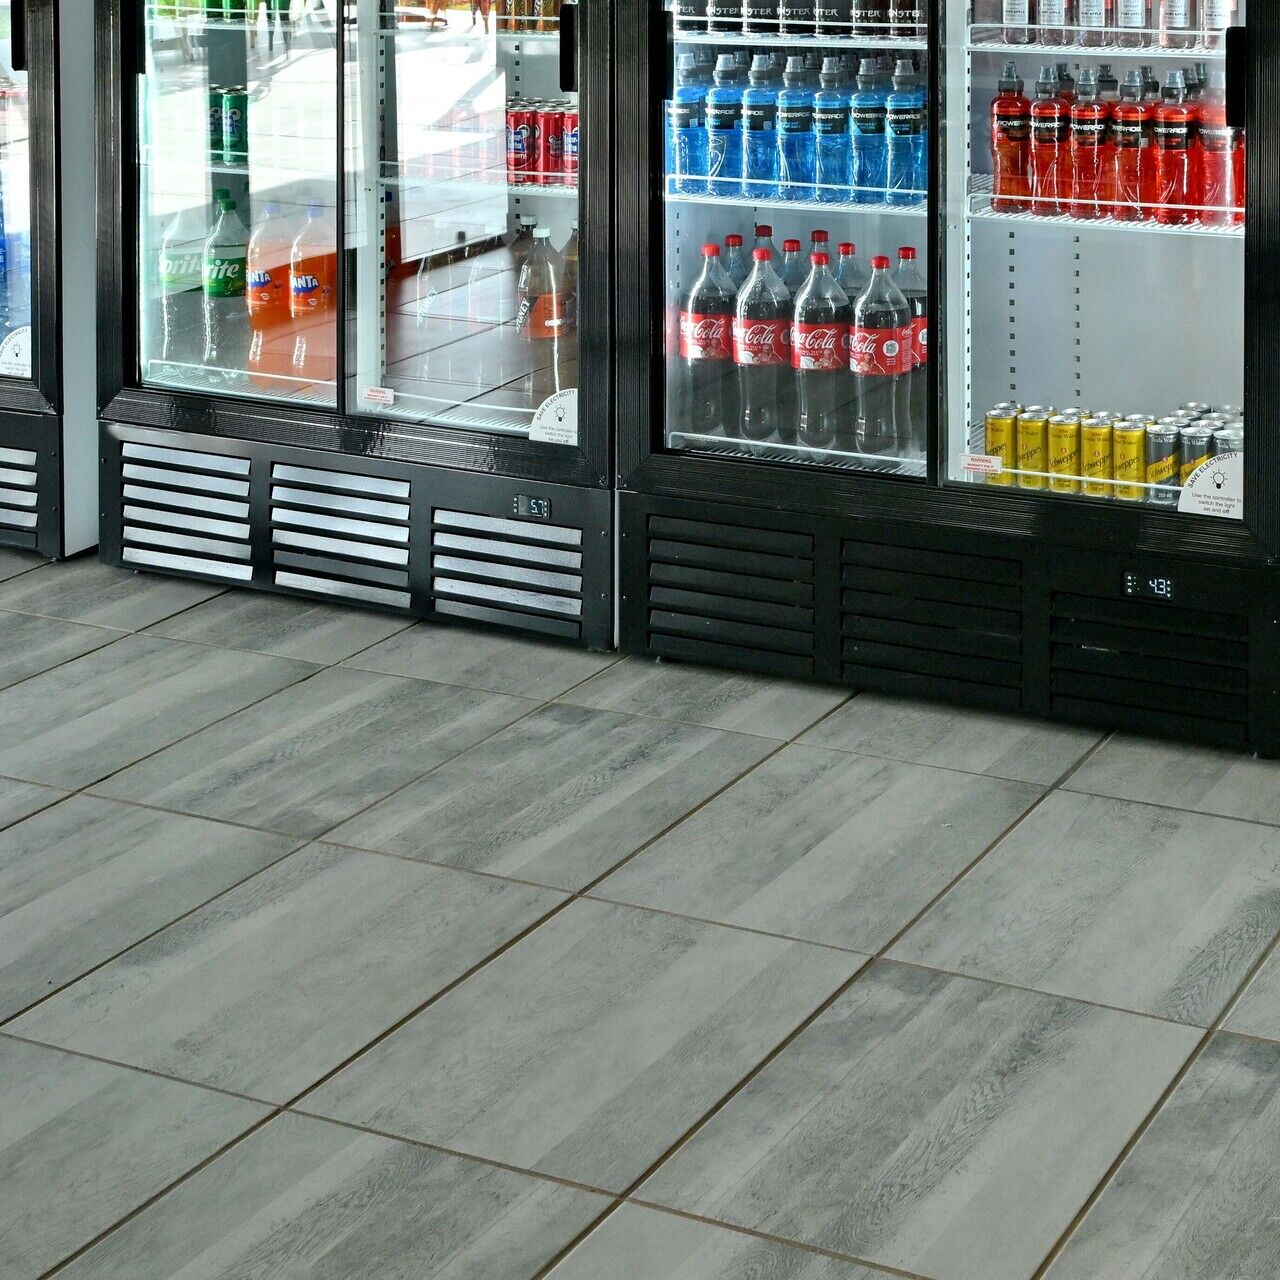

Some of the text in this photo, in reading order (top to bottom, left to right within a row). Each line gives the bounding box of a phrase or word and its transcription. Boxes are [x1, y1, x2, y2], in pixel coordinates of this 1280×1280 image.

[292, 275, 320, 288] ANTA
[1188, 452, 1238, 488] SAVE ELECTRICITY
